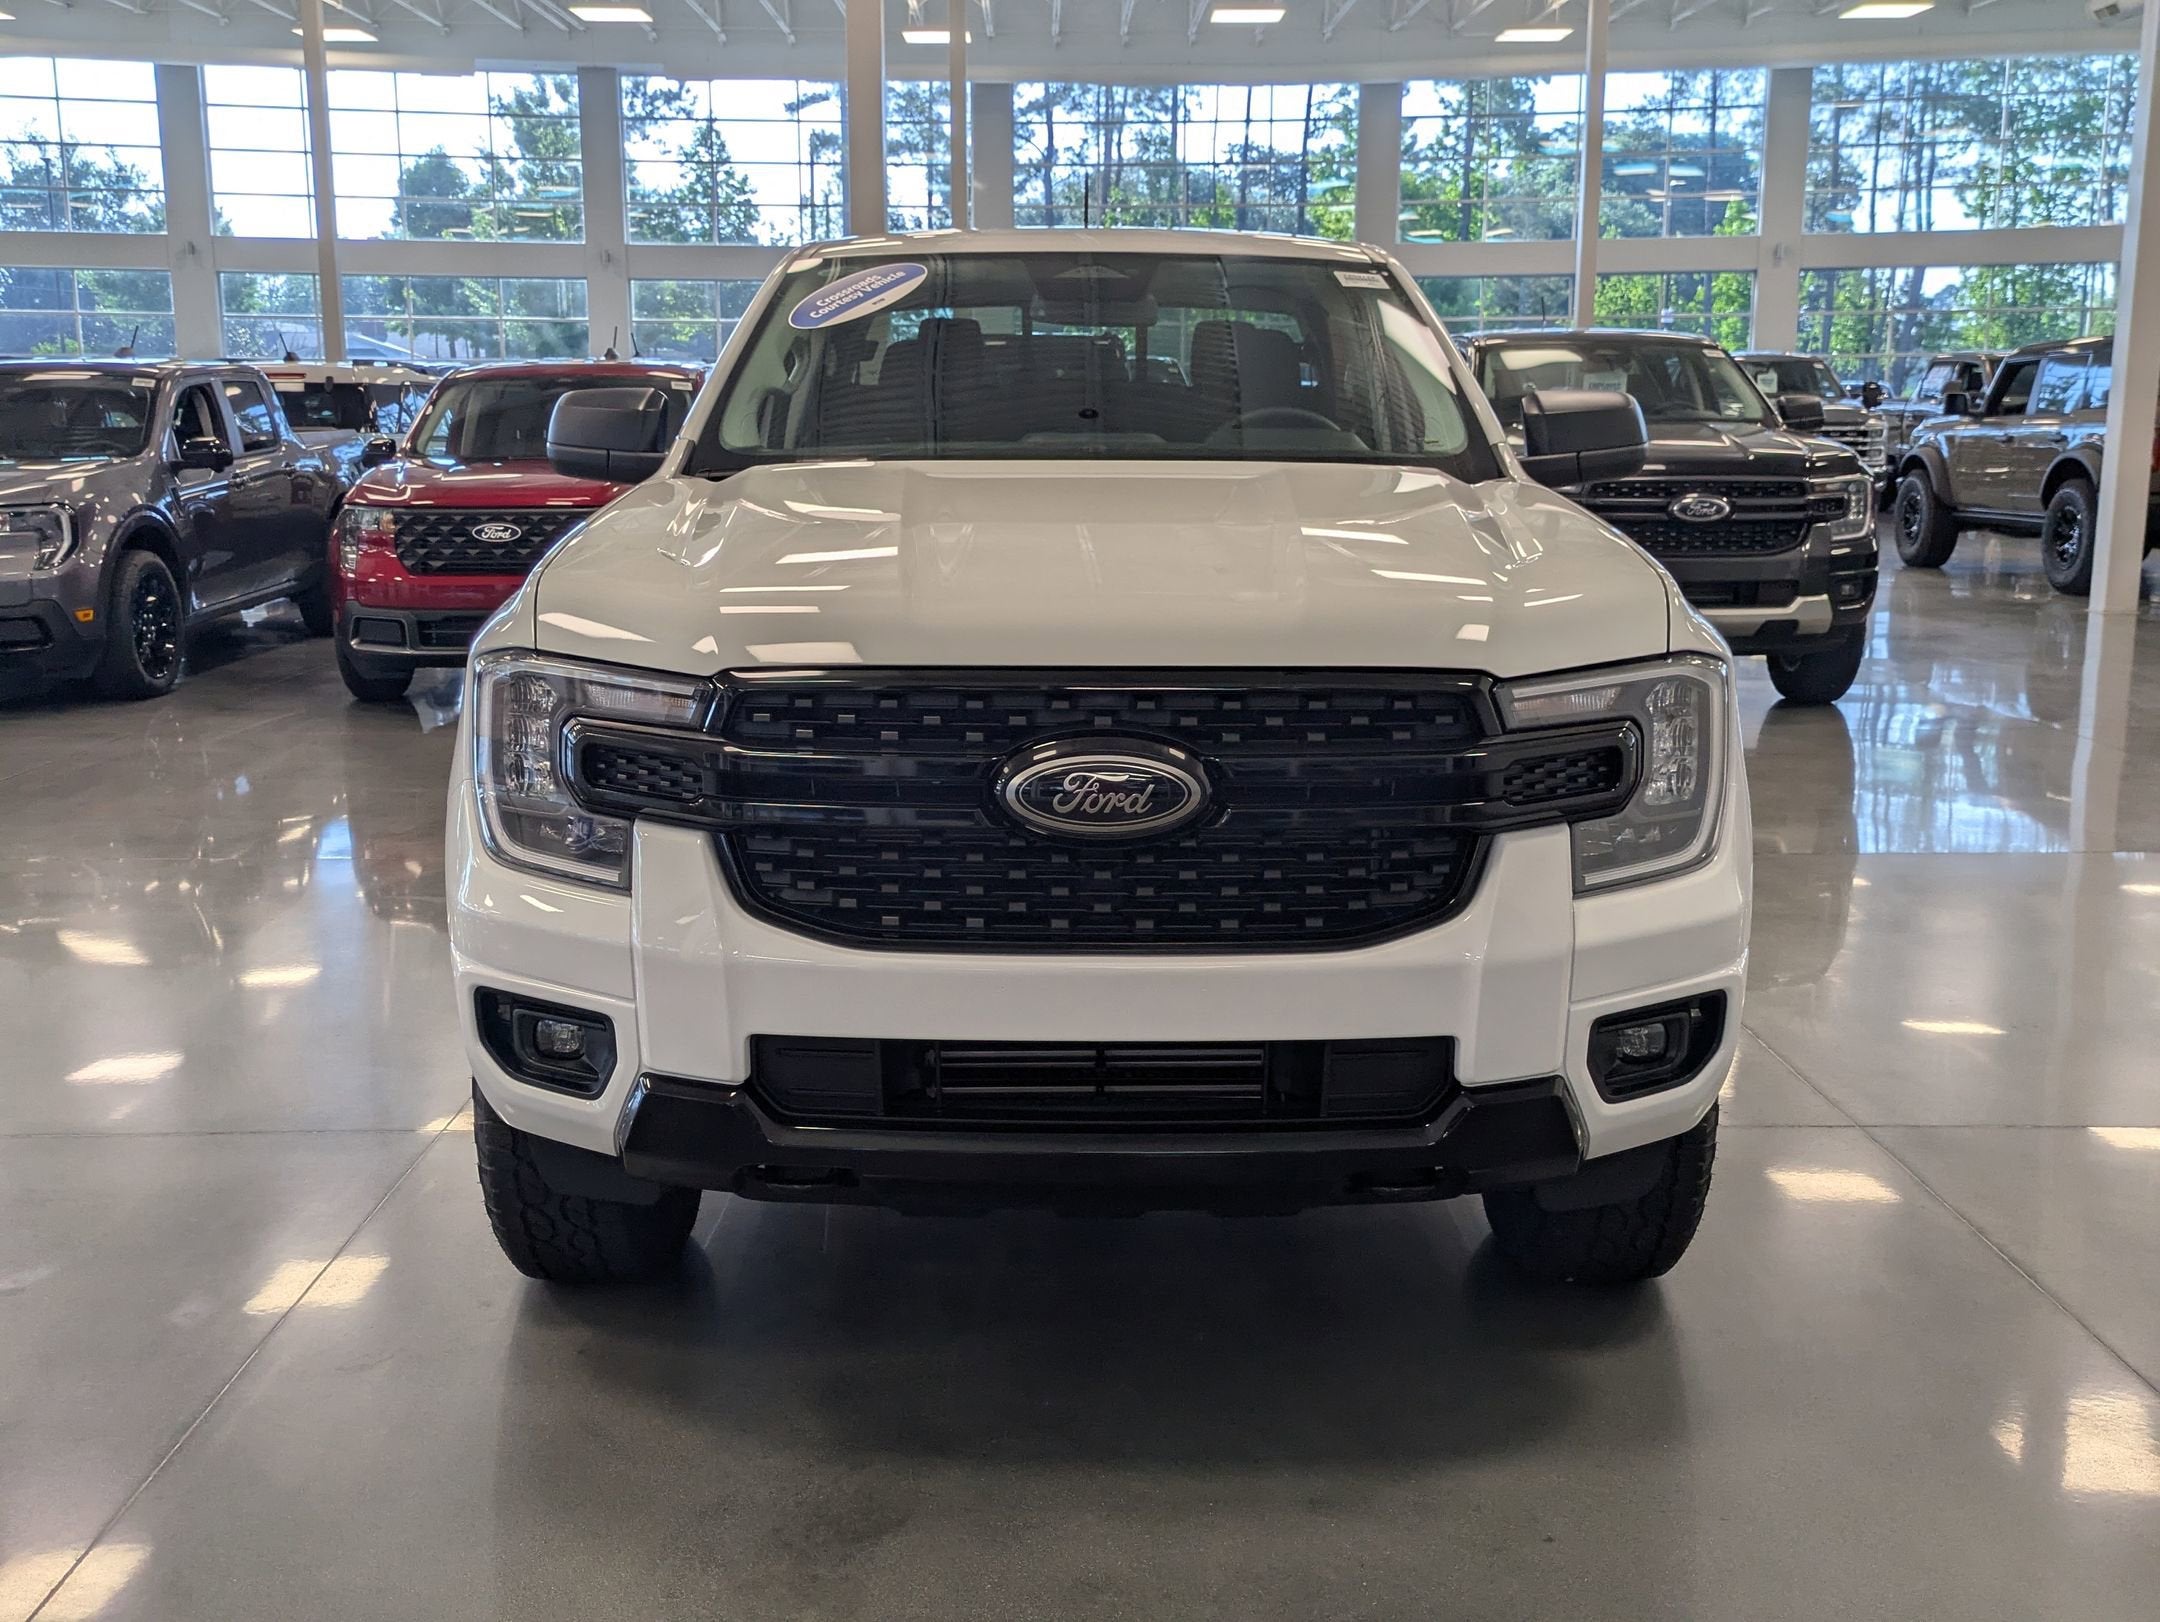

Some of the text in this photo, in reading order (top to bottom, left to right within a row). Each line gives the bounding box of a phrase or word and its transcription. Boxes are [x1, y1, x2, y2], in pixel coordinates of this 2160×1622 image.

[809, 271, 906, 318] Courtesy Vehicle
[816, 274, 881, 307] Crossroads
[1686, 502, 1717, 516] Ford
[481, 526, 512, 539] Ford
[1053, 772, 1155, 814] Ford
